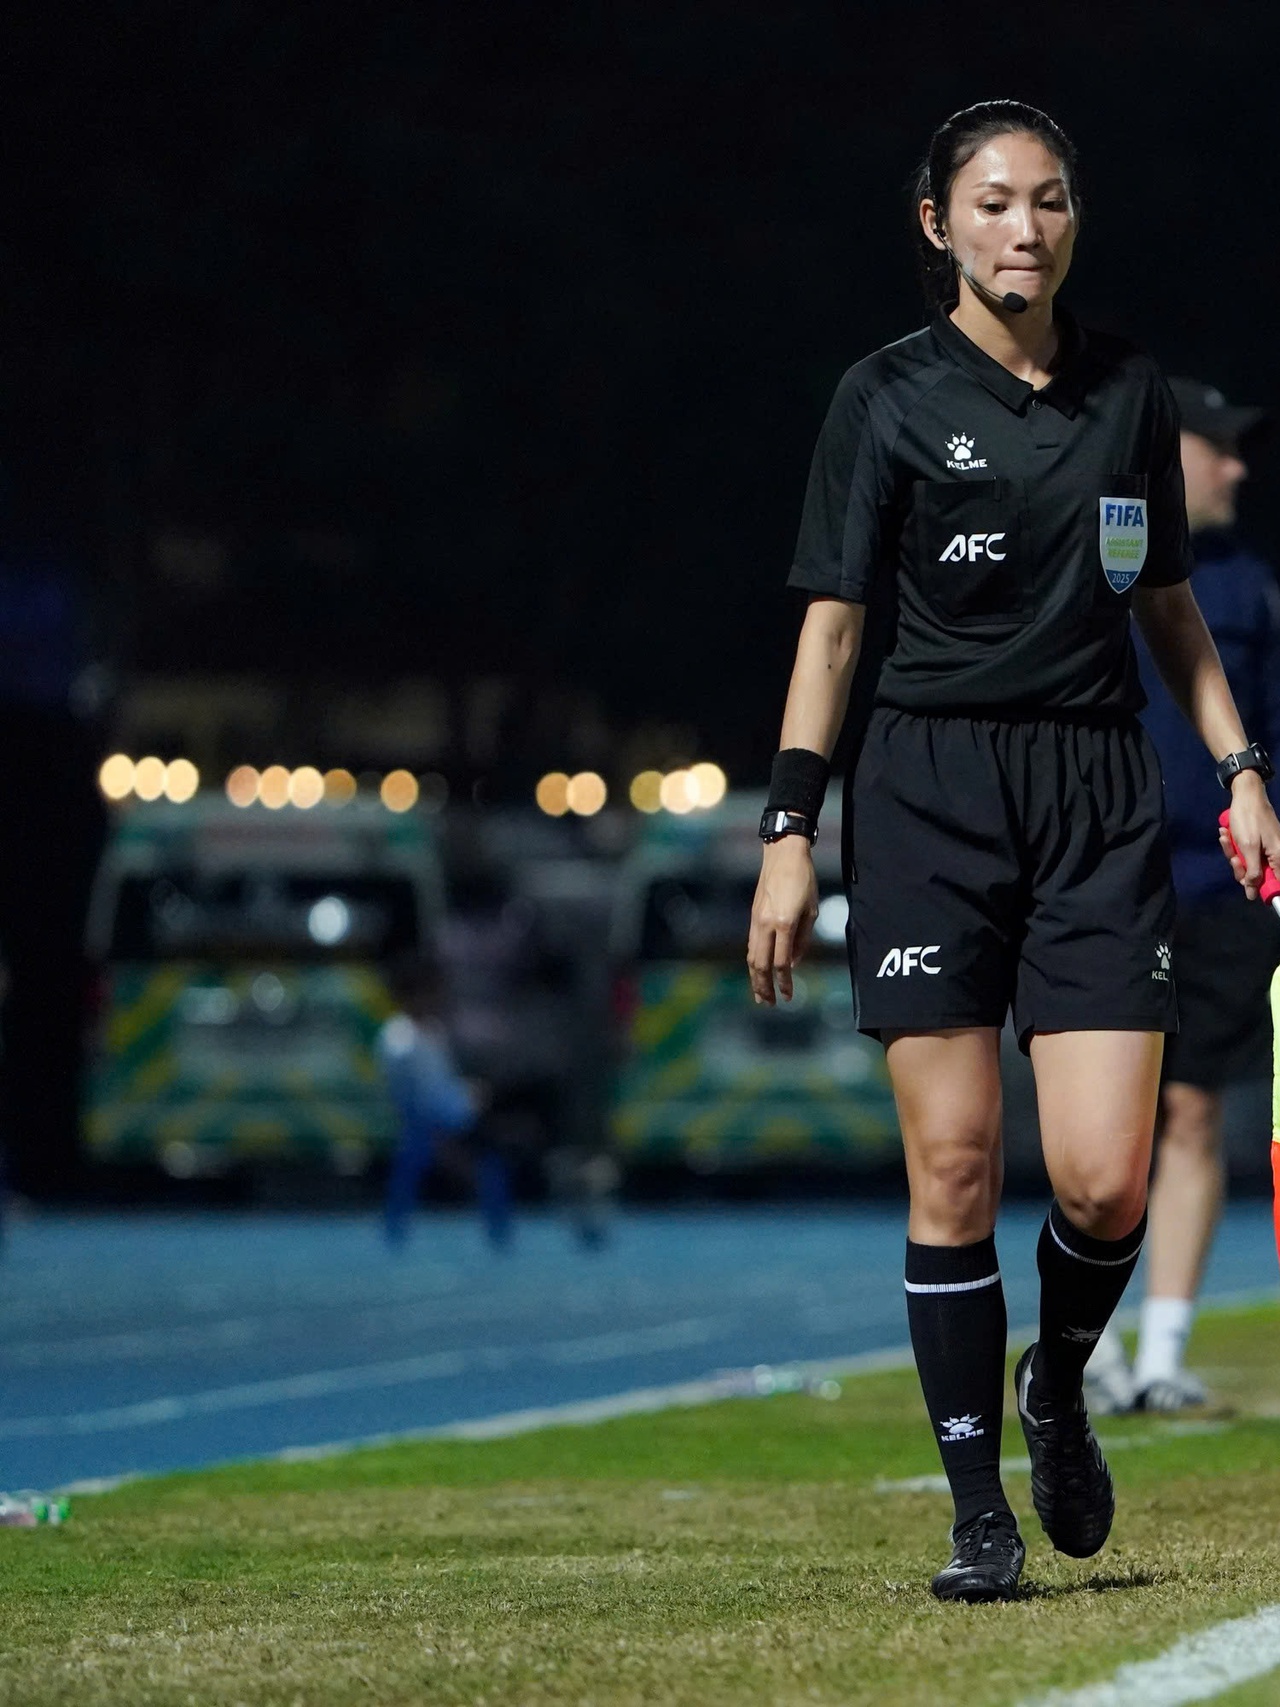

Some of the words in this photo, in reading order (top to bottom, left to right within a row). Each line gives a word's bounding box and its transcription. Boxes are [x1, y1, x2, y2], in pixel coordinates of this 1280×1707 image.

[946, 459, 988, 471] KELME
[1105, 503, 1145, 528] FIFA
[938, 532, 1007, 562] AFC
[1112, 573, 1131, 584] 2025
[876, 945, 942, 978] AFC
[1151, 970, 1170, 982] KEL
